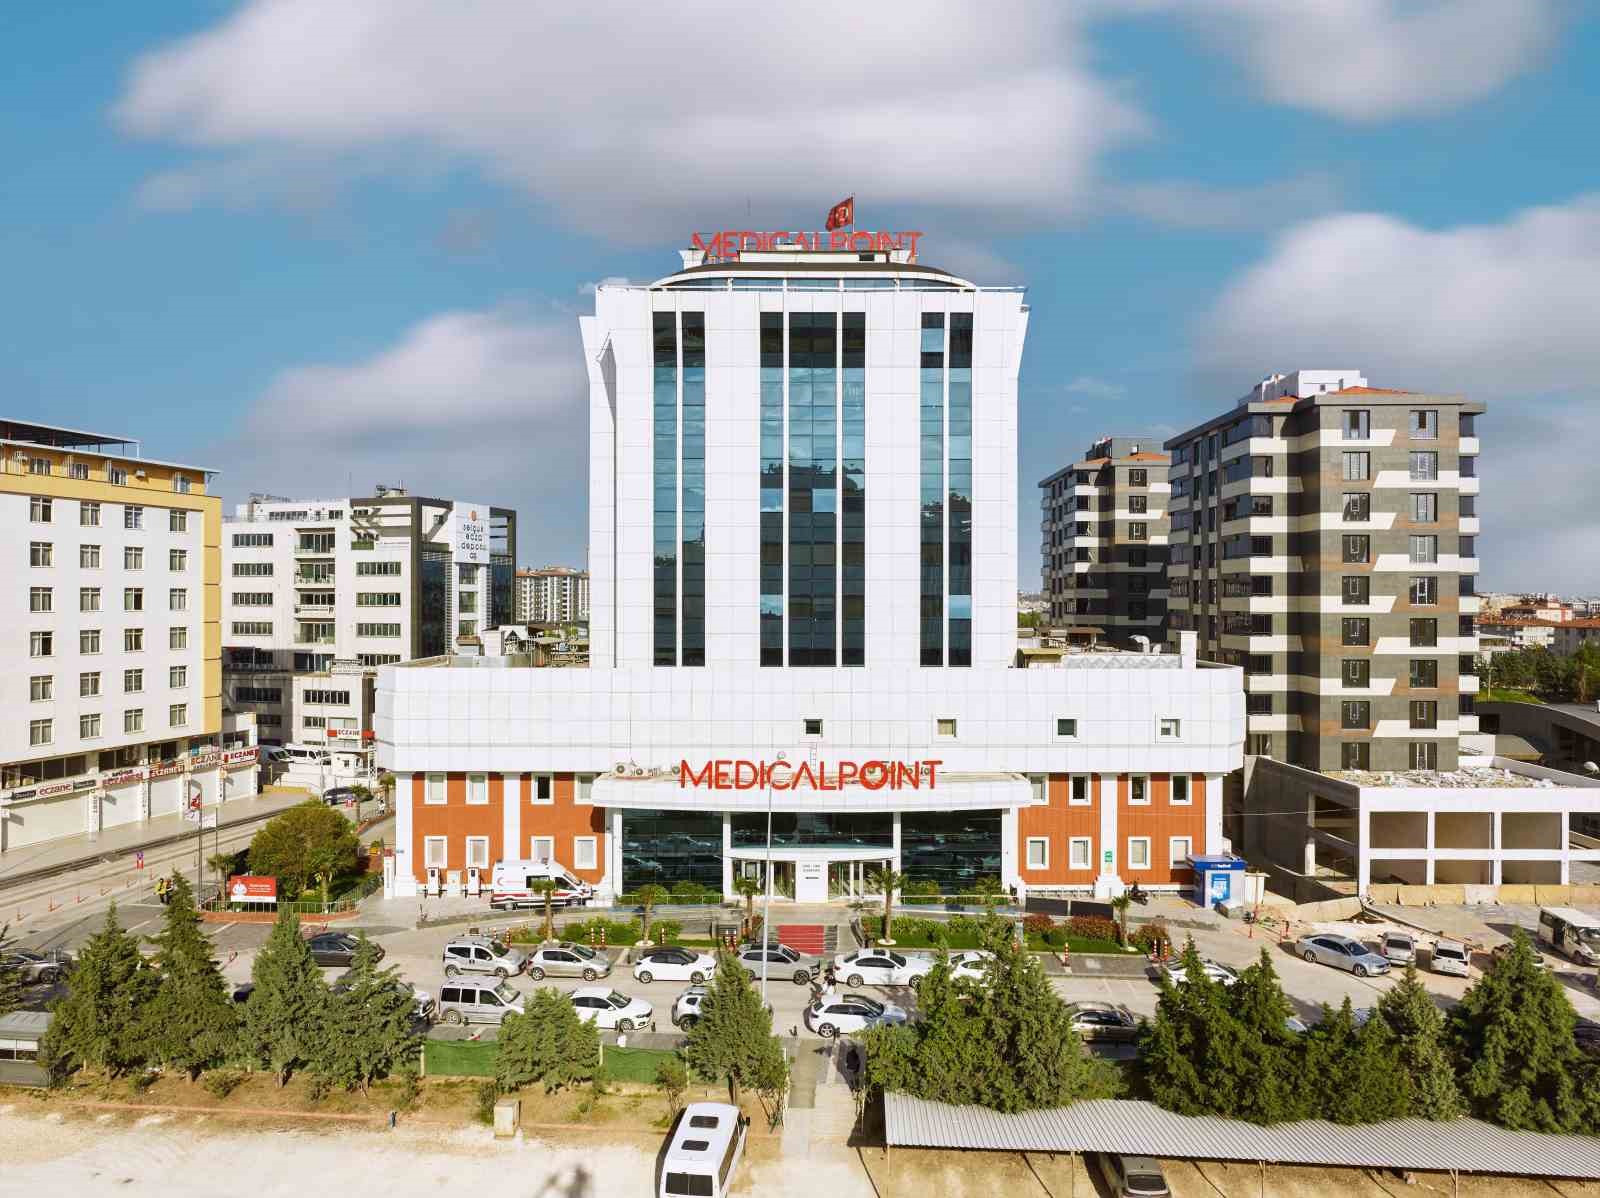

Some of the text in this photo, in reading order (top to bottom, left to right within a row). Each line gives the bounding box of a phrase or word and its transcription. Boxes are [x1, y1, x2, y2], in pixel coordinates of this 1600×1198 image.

[230, 749, 257, 760] ECZANE
[680, 760, 943, 791] MEDICALPOINT
[39, 783, 72, 797] eczane
